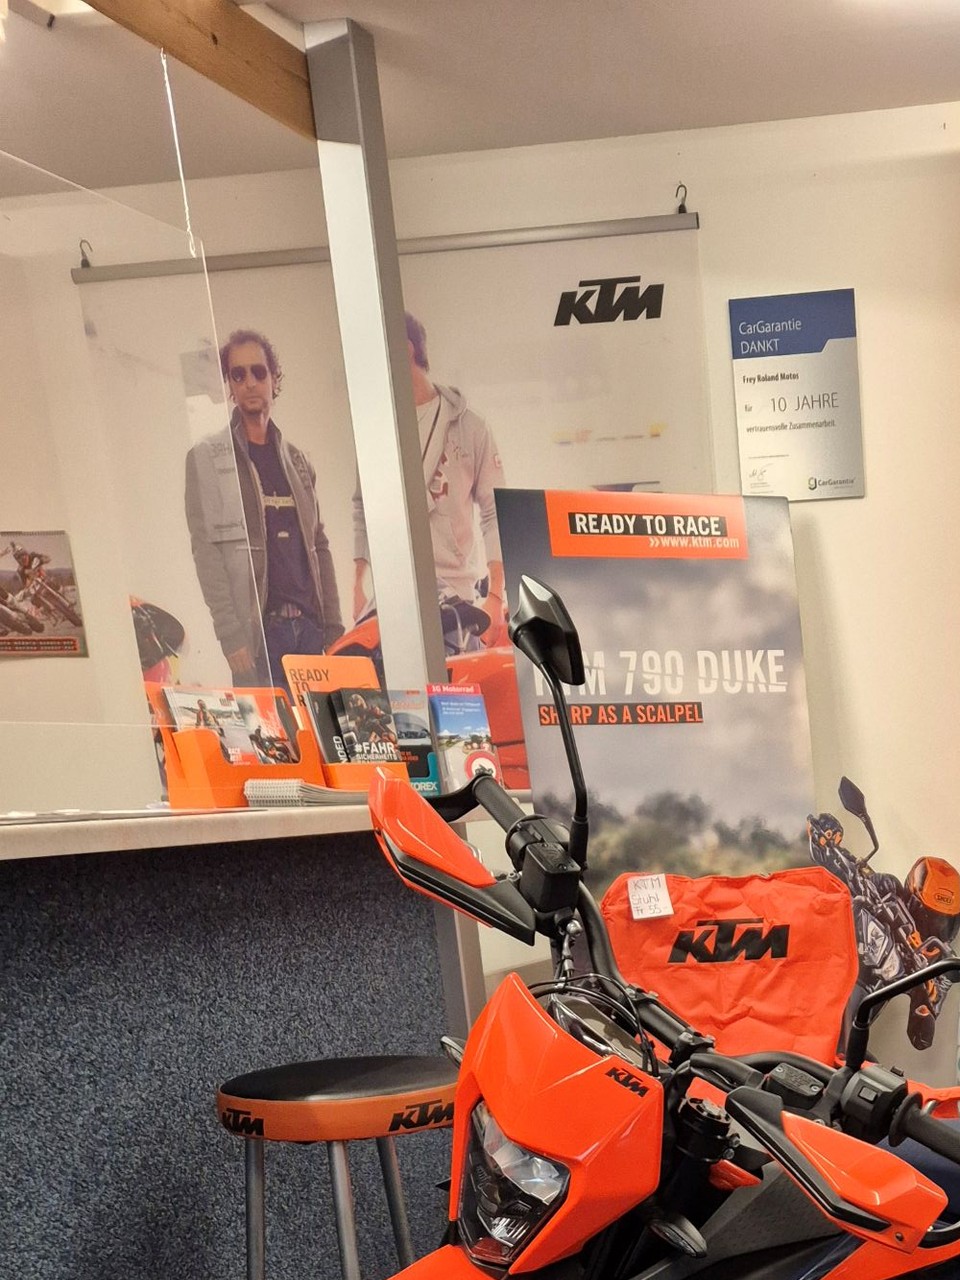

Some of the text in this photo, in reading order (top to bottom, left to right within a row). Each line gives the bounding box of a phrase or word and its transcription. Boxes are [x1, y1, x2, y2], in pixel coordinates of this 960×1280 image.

[554, 275, 664, 326] KTM
[738, 317, 802, 335] CarGarantie
[740, 338, 779, 354] DANKT
[742, 371, 800, 385] Frey Roland Motos
[744, 391, 840, 413] für 10 JAHRE
[746, 423, 788, 434] vertrauensvolle
[575, 513, 722, 536] READY TO RACE
[289, 667, 330, 682] READY
[619, 650, 685, 696] 790
[697, 649, 788, 694] DUKE
[442, 684, 475, 693] Motorrad
[539, 703, 704, 725] SHRP AS A SCALPEL
[354, 741, 396, 755] #FAHR
[411, 781, 438, 792] OREX
[632, 877, 661, 890] KTM
[667, 917, 791, 964] KTM
[605, 1067, 650, 1098] KTM
[222, 1107, 264, 1136] KTM
[388, 1099, 455, 1132] KTM
